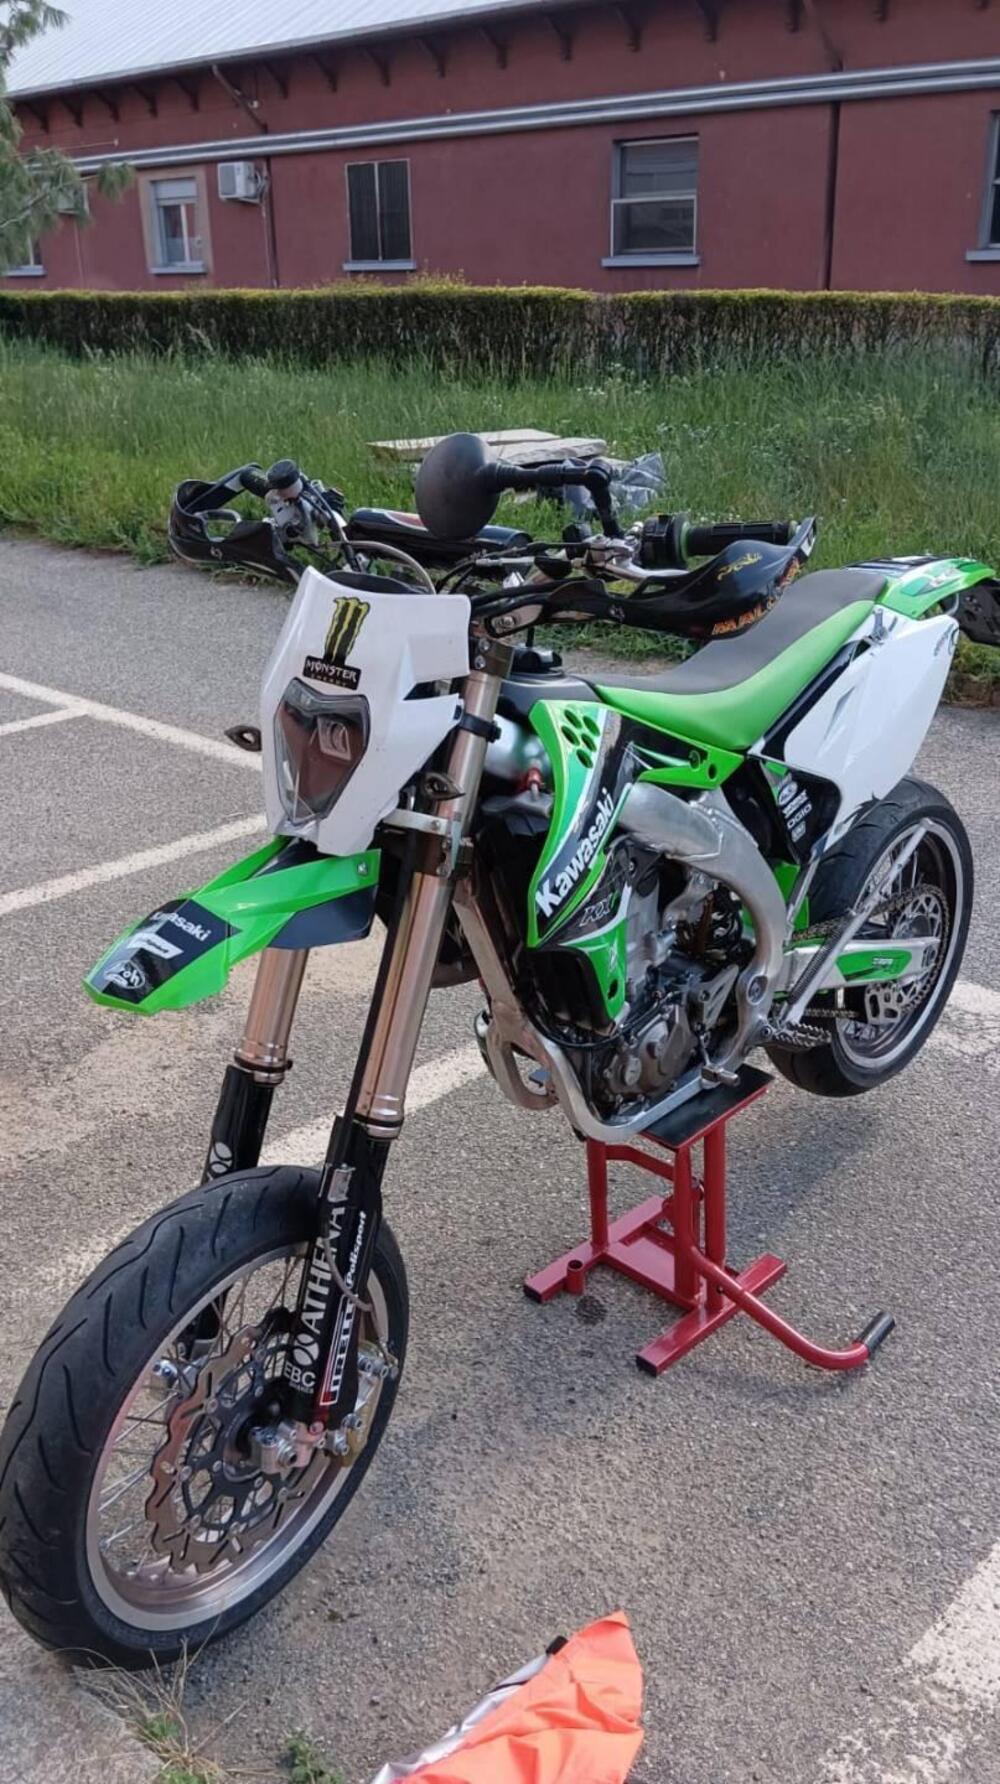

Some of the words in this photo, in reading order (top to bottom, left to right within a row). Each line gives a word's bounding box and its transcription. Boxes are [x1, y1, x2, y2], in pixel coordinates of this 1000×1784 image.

[305, 659, 357, 683] MONSTER
[535, 787, 615, 918] Kawasaki
[301, 1206, 346, 1335] ATHENA
[346, 1210, 367, 1288] Polisport
[283, 1361, 317, 1388] EBC
